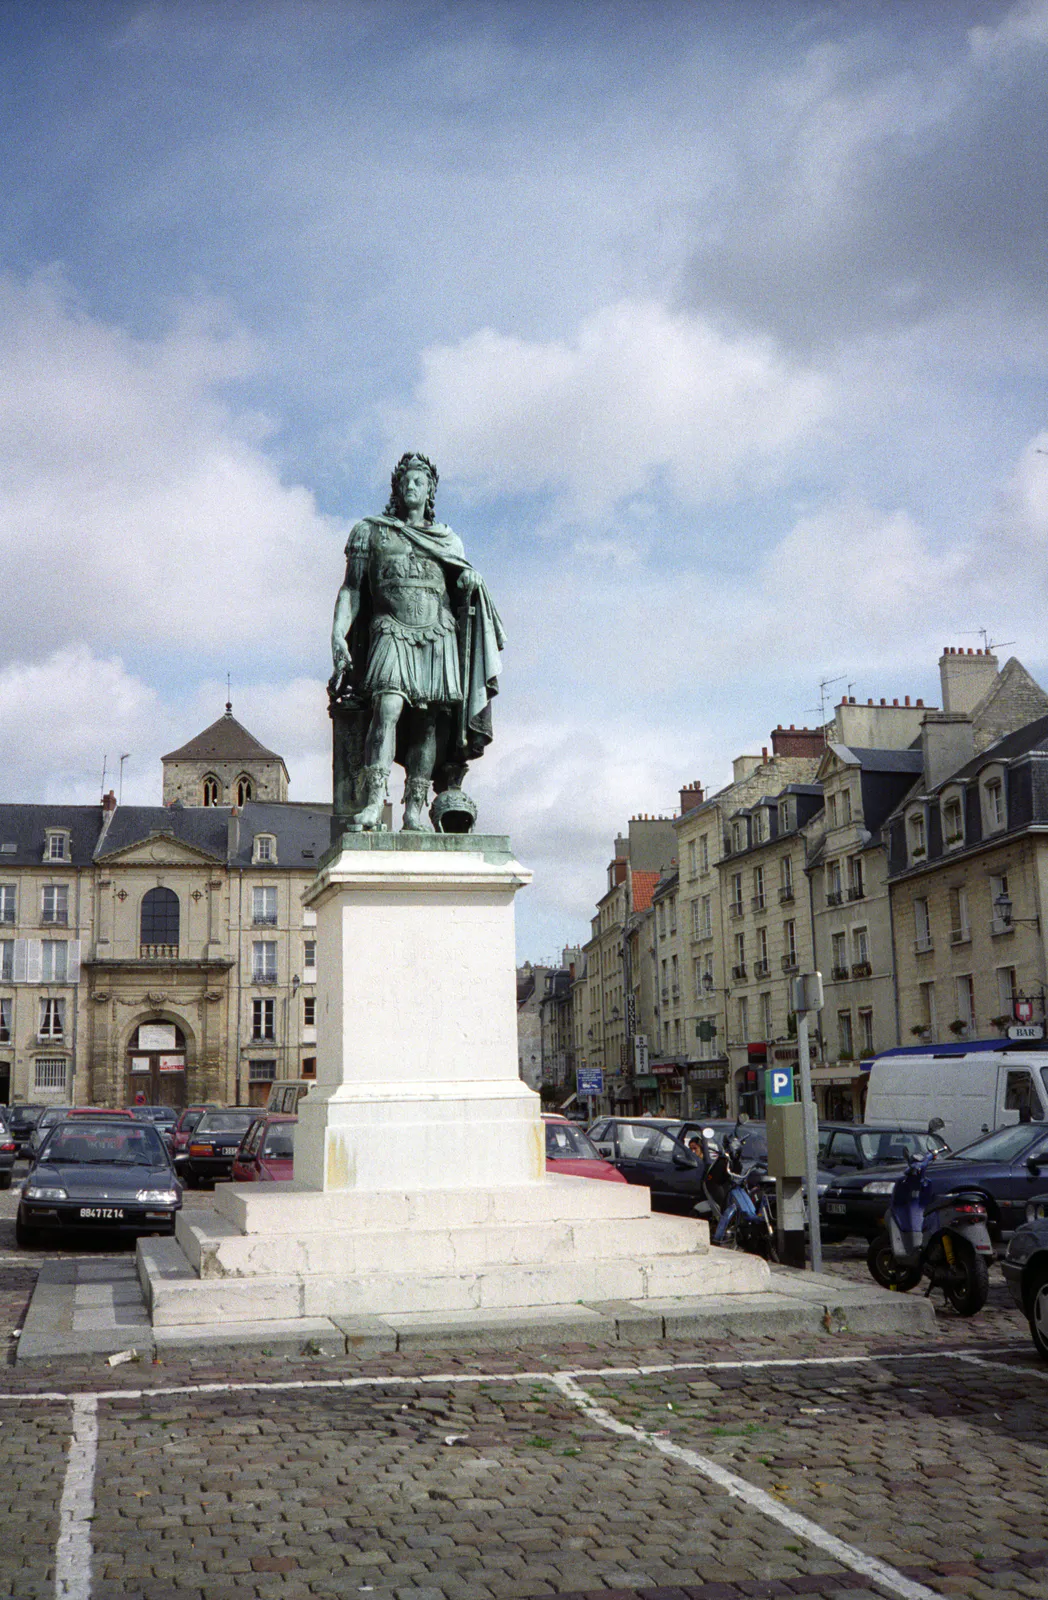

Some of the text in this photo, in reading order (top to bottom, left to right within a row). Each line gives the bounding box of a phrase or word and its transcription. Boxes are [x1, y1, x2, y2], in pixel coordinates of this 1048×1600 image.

[1016, 1028, 1035, 1036] BAR
[773, 1073, 788, 1094] P
[114, 1208, 124, 1218] 14
